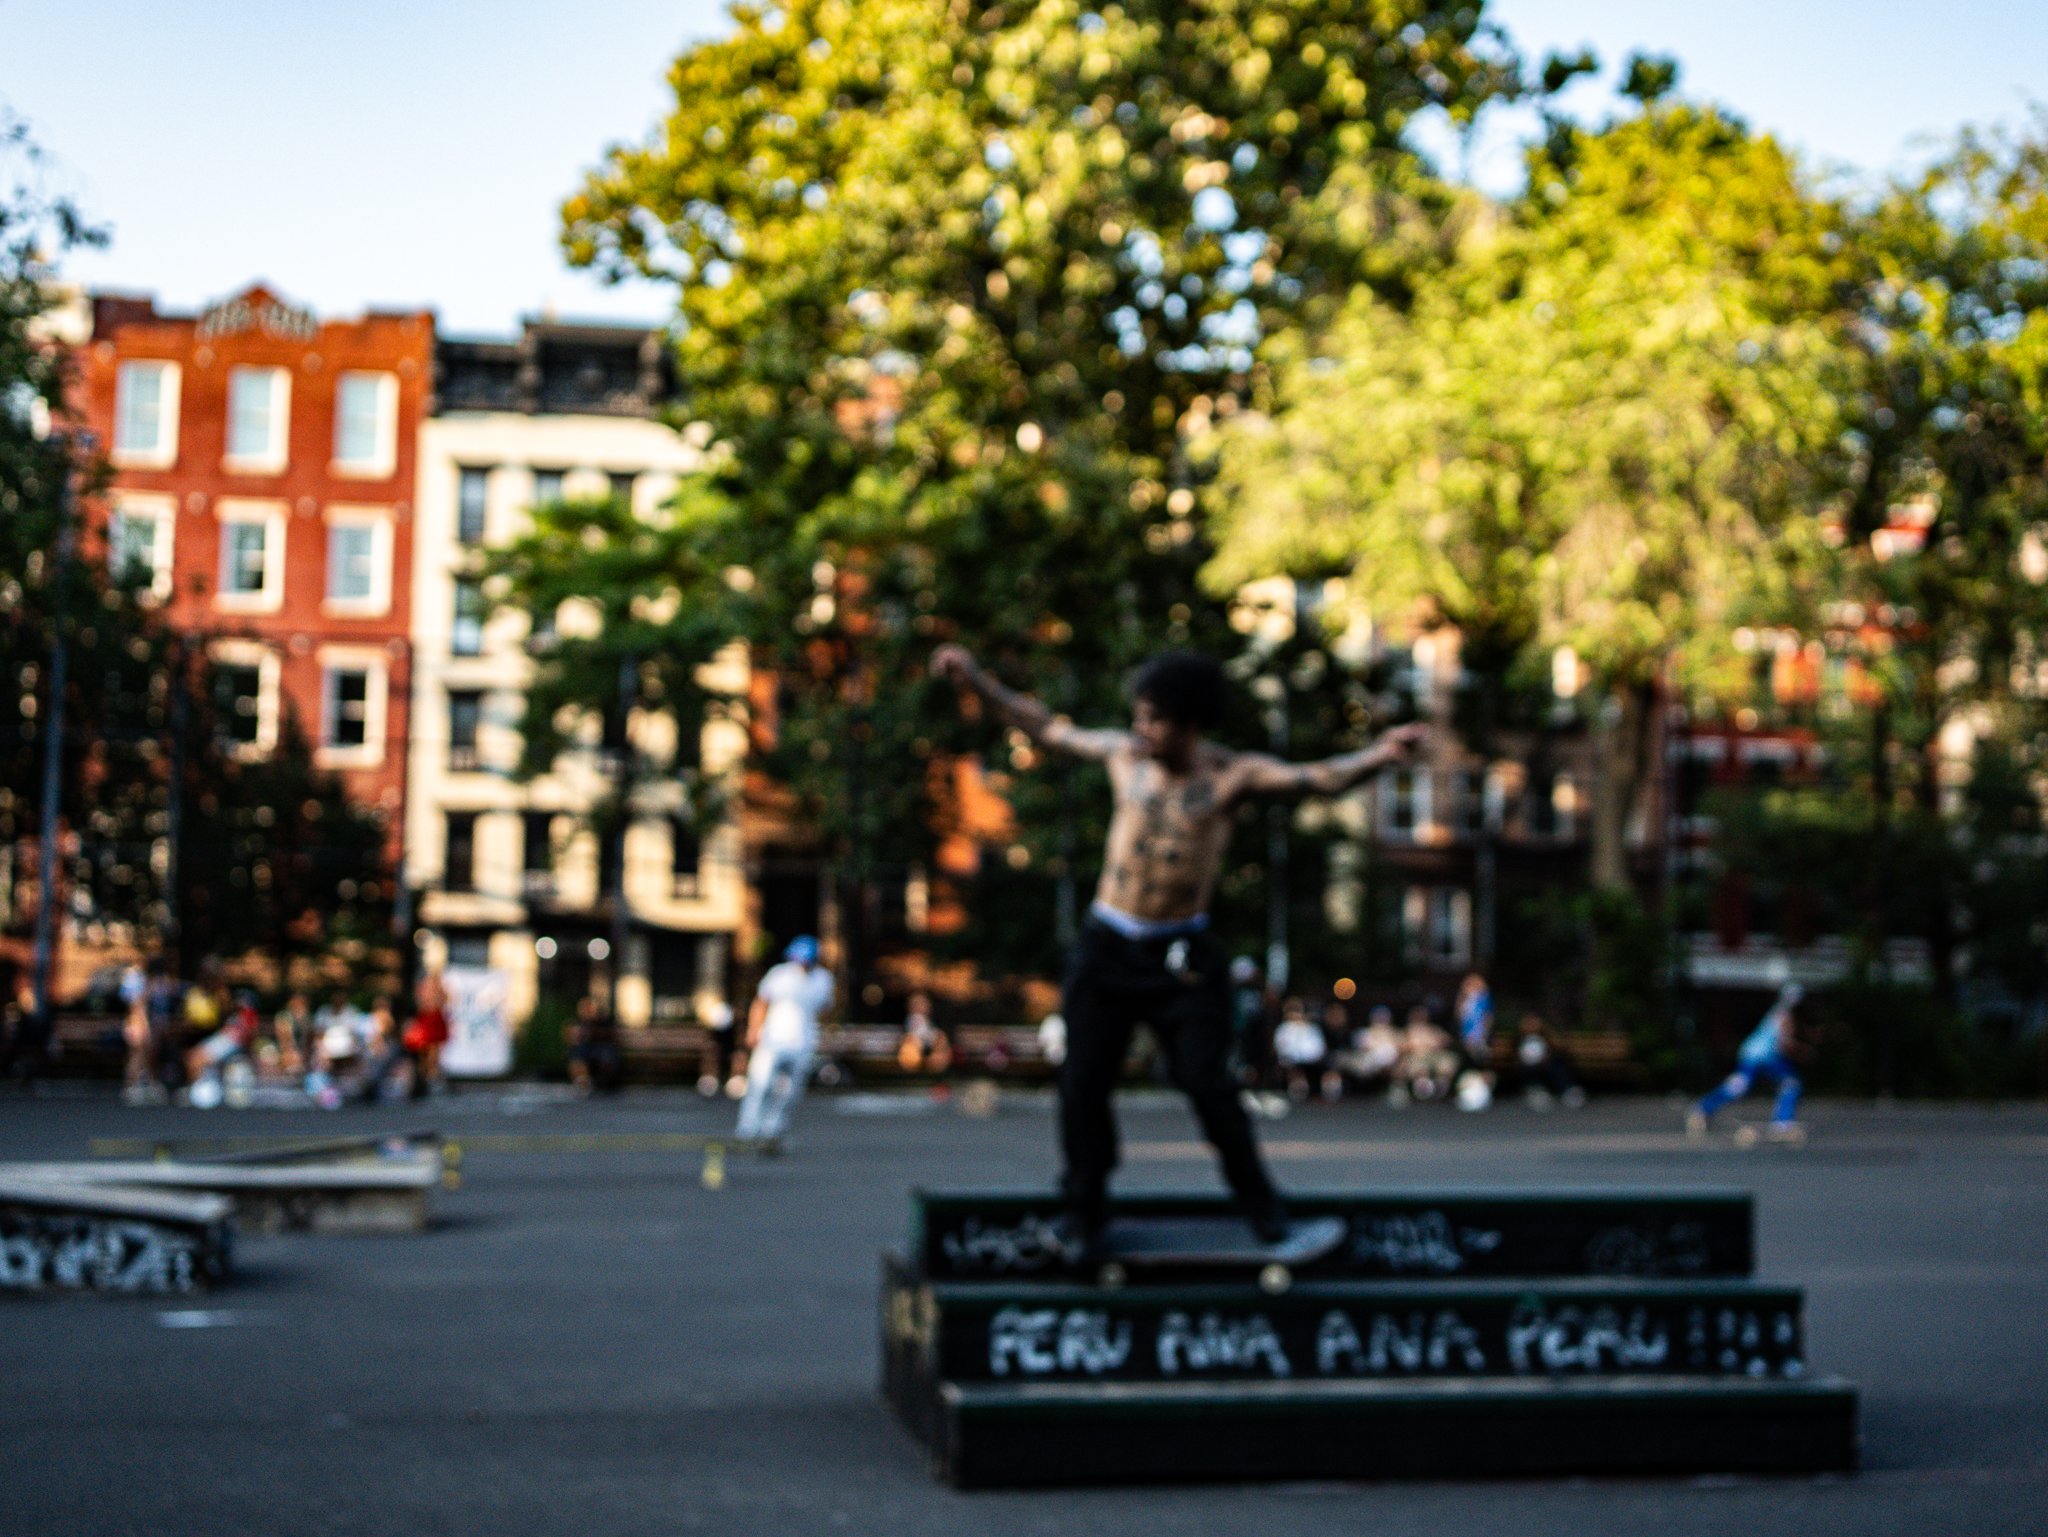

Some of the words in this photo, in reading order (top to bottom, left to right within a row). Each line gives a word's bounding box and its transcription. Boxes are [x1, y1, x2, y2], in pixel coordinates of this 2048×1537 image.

[990, 1308, 1131, 1374] PERU
[1317, 1309, 1486, 1371] ANA
[1509, 1305, 1668, 1371] PERU
